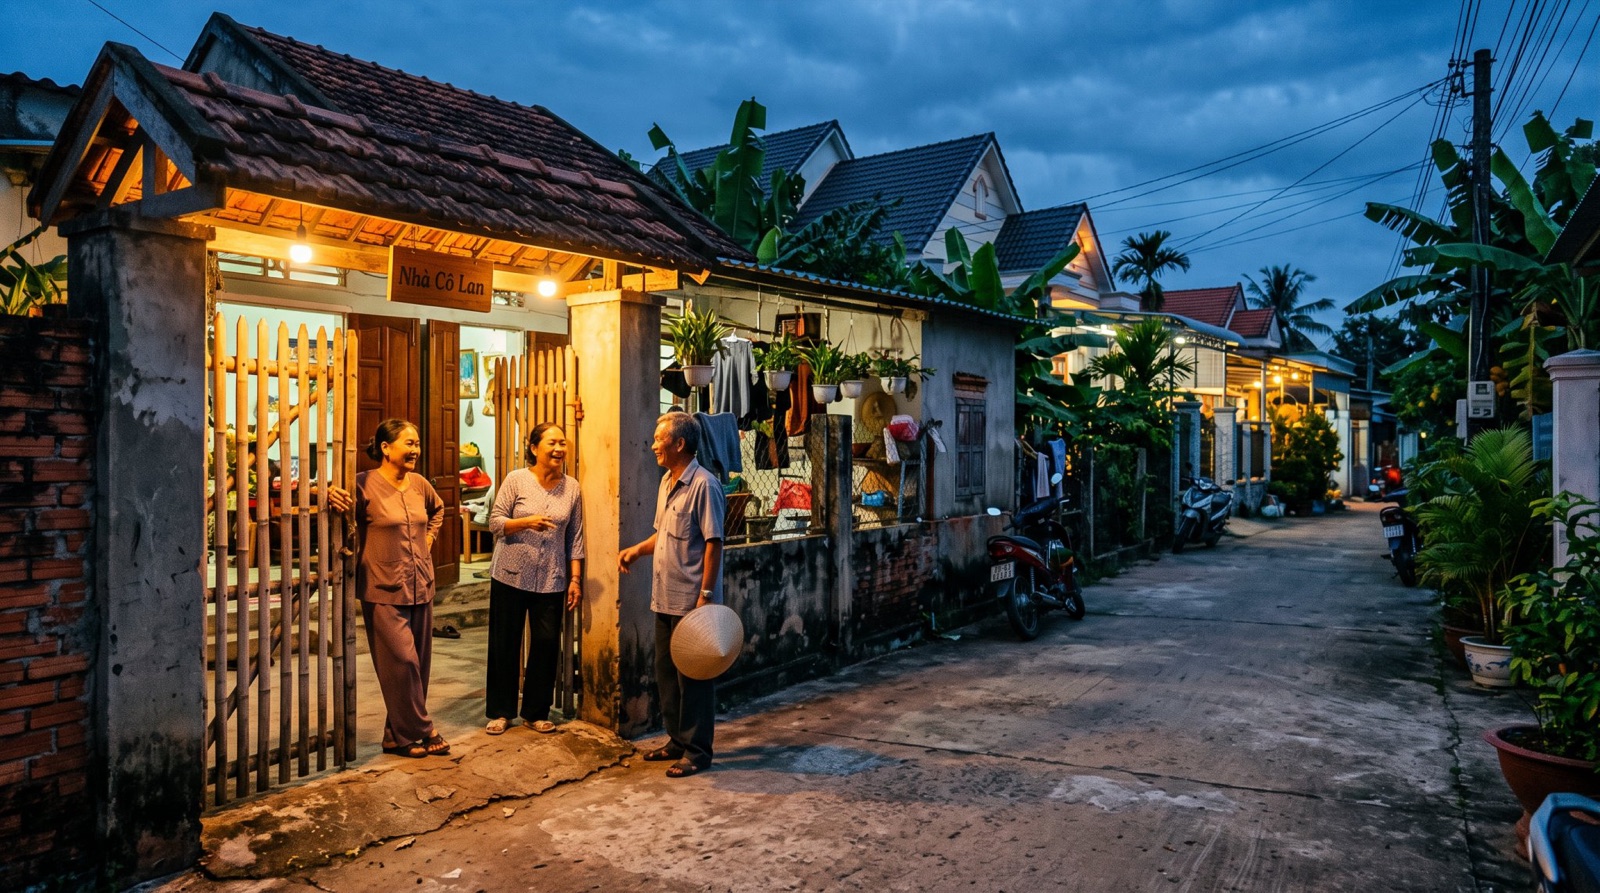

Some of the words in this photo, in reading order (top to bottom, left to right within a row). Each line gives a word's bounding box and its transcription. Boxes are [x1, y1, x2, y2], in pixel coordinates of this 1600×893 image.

[398, 265, 430, 288] Nhà
[435, 271, 454, 292] Cô
[458, 274, 484, 295] Lan
